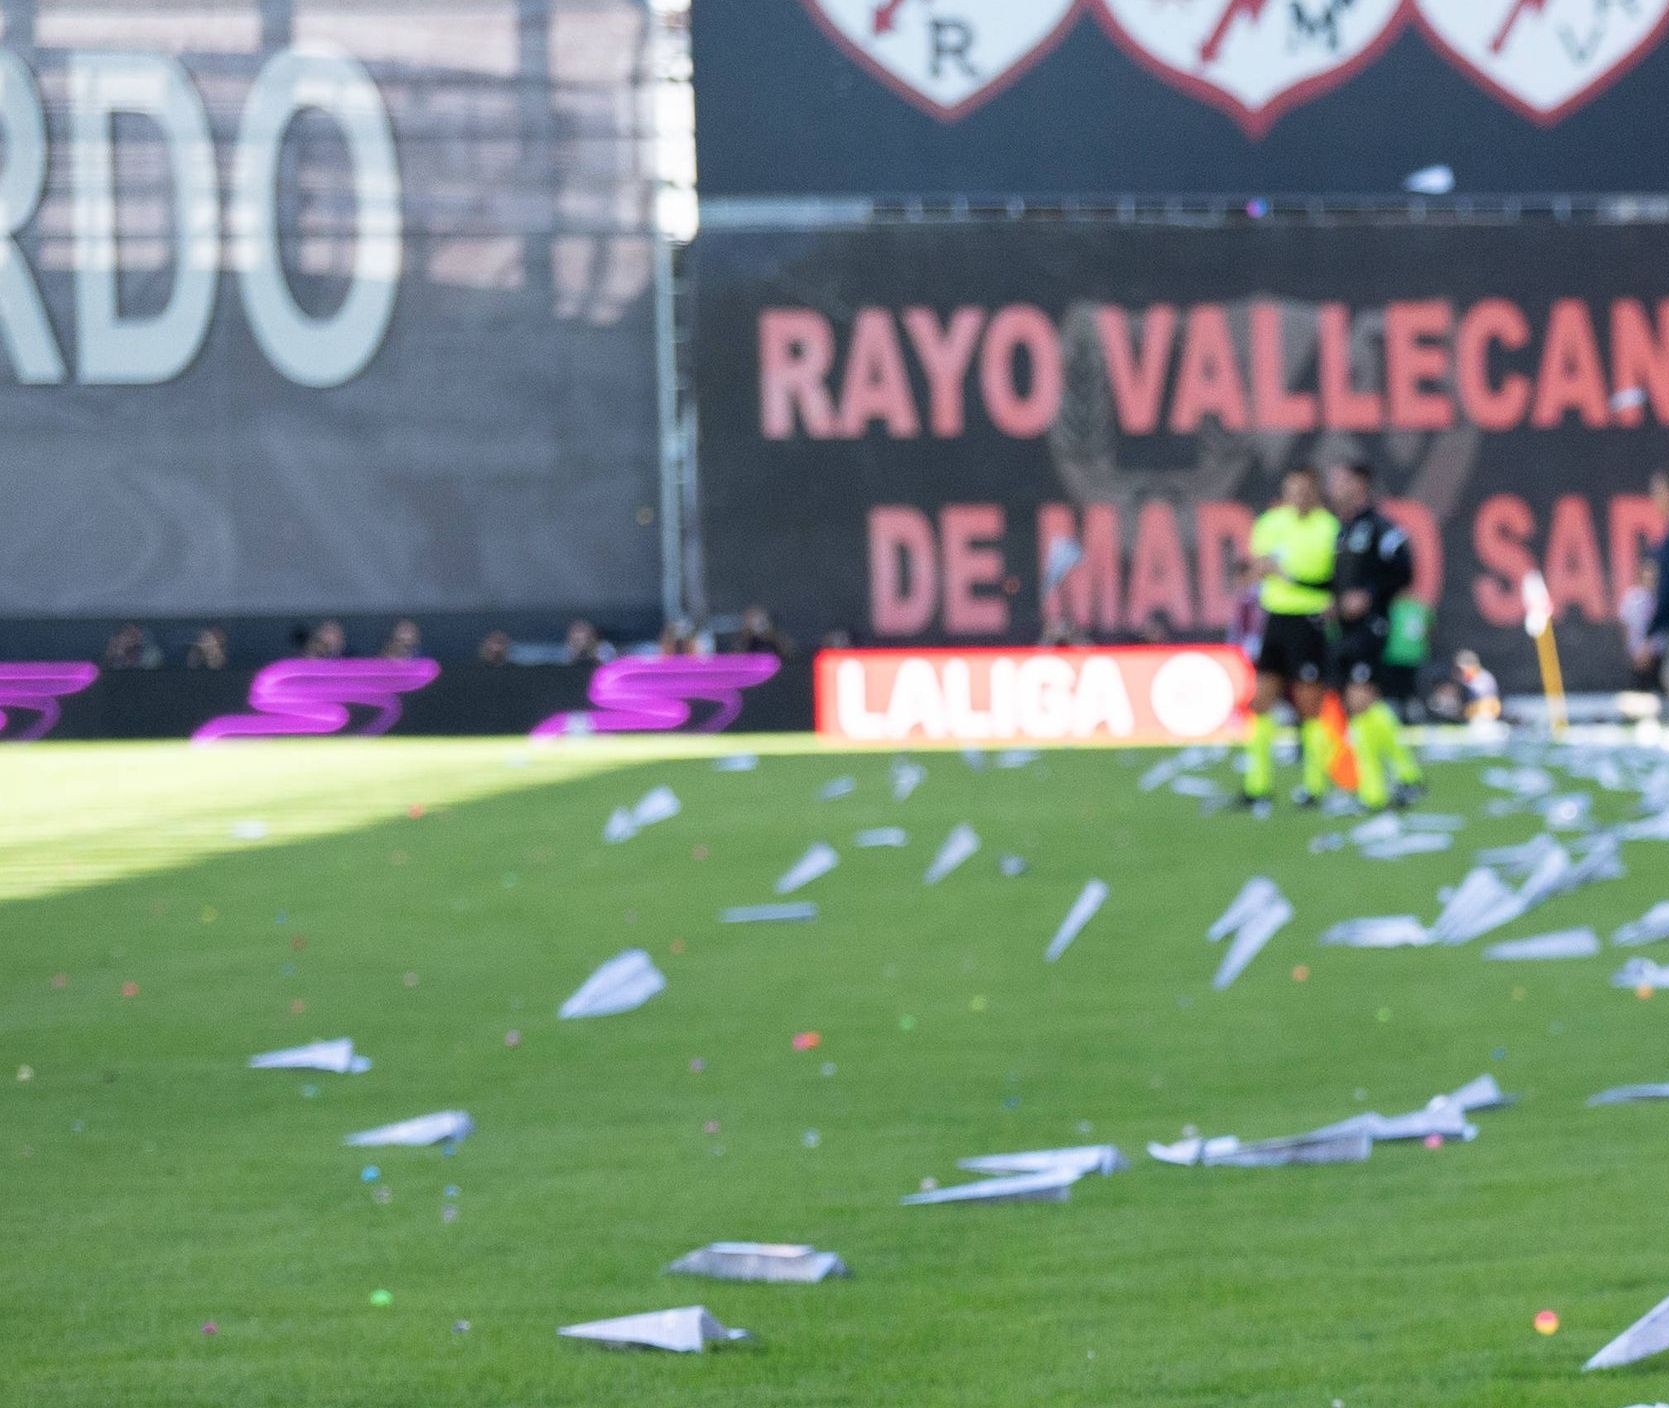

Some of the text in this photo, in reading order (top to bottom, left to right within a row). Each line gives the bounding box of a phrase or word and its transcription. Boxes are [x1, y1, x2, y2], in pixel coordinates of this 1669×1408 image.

[758, 303, 1063, 440] RAYO
[867, 503, 1004, 637] DE
[834, 656, 1137, 742] LALIGA
